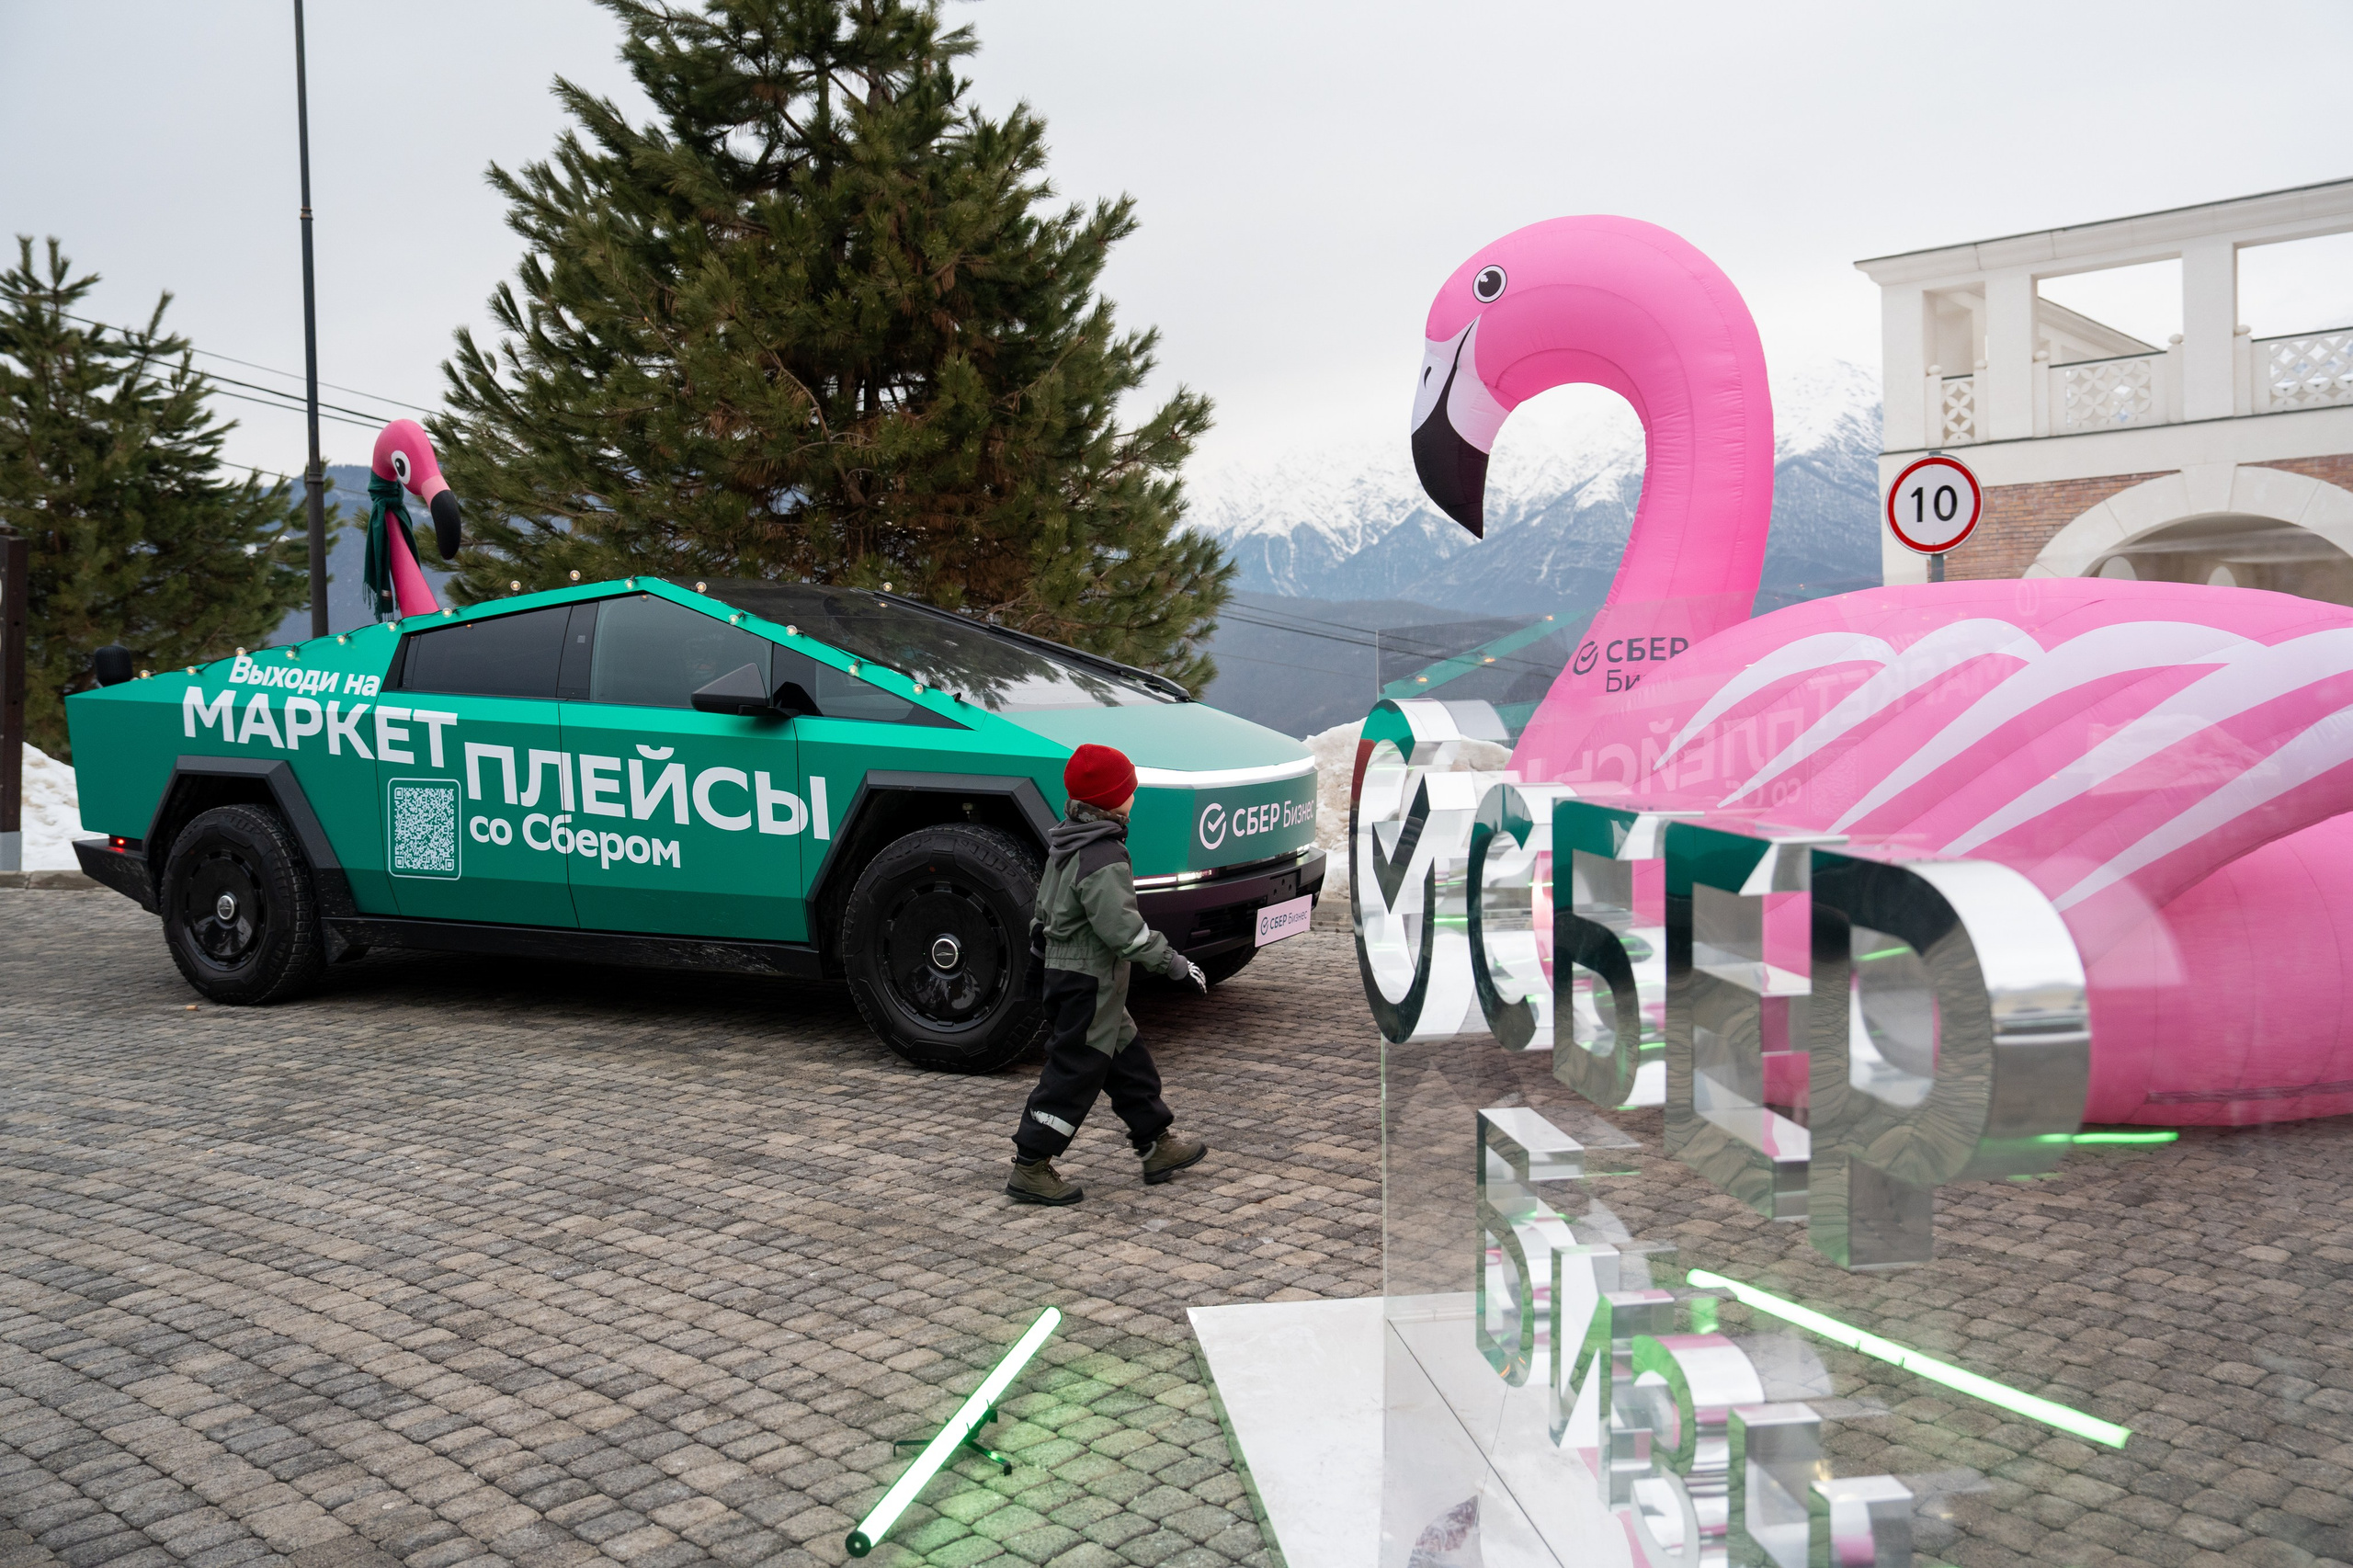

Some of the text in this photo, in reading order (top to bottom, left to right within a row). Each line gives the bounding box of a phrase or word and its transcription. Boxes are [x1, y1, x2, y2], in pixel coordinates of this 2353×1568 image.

[1910, 484, 1958, 523] 10
[1606, 636, 1689, 663] СБЕР
[229, 654, 381, 698] Выходи на
[183, 685, 459, 769] МАРКЕТ
[464, 741, 831, 841] ПЛЕЙСЫ
[469, 812, 681, 869] со Сбером
[1233, 800, 1314, 837] СБЕР Бизнес
[1270, 911, 1308, 930] СБЕР Бизнес
[1467, 780, 2091, 1272] СБЕР
